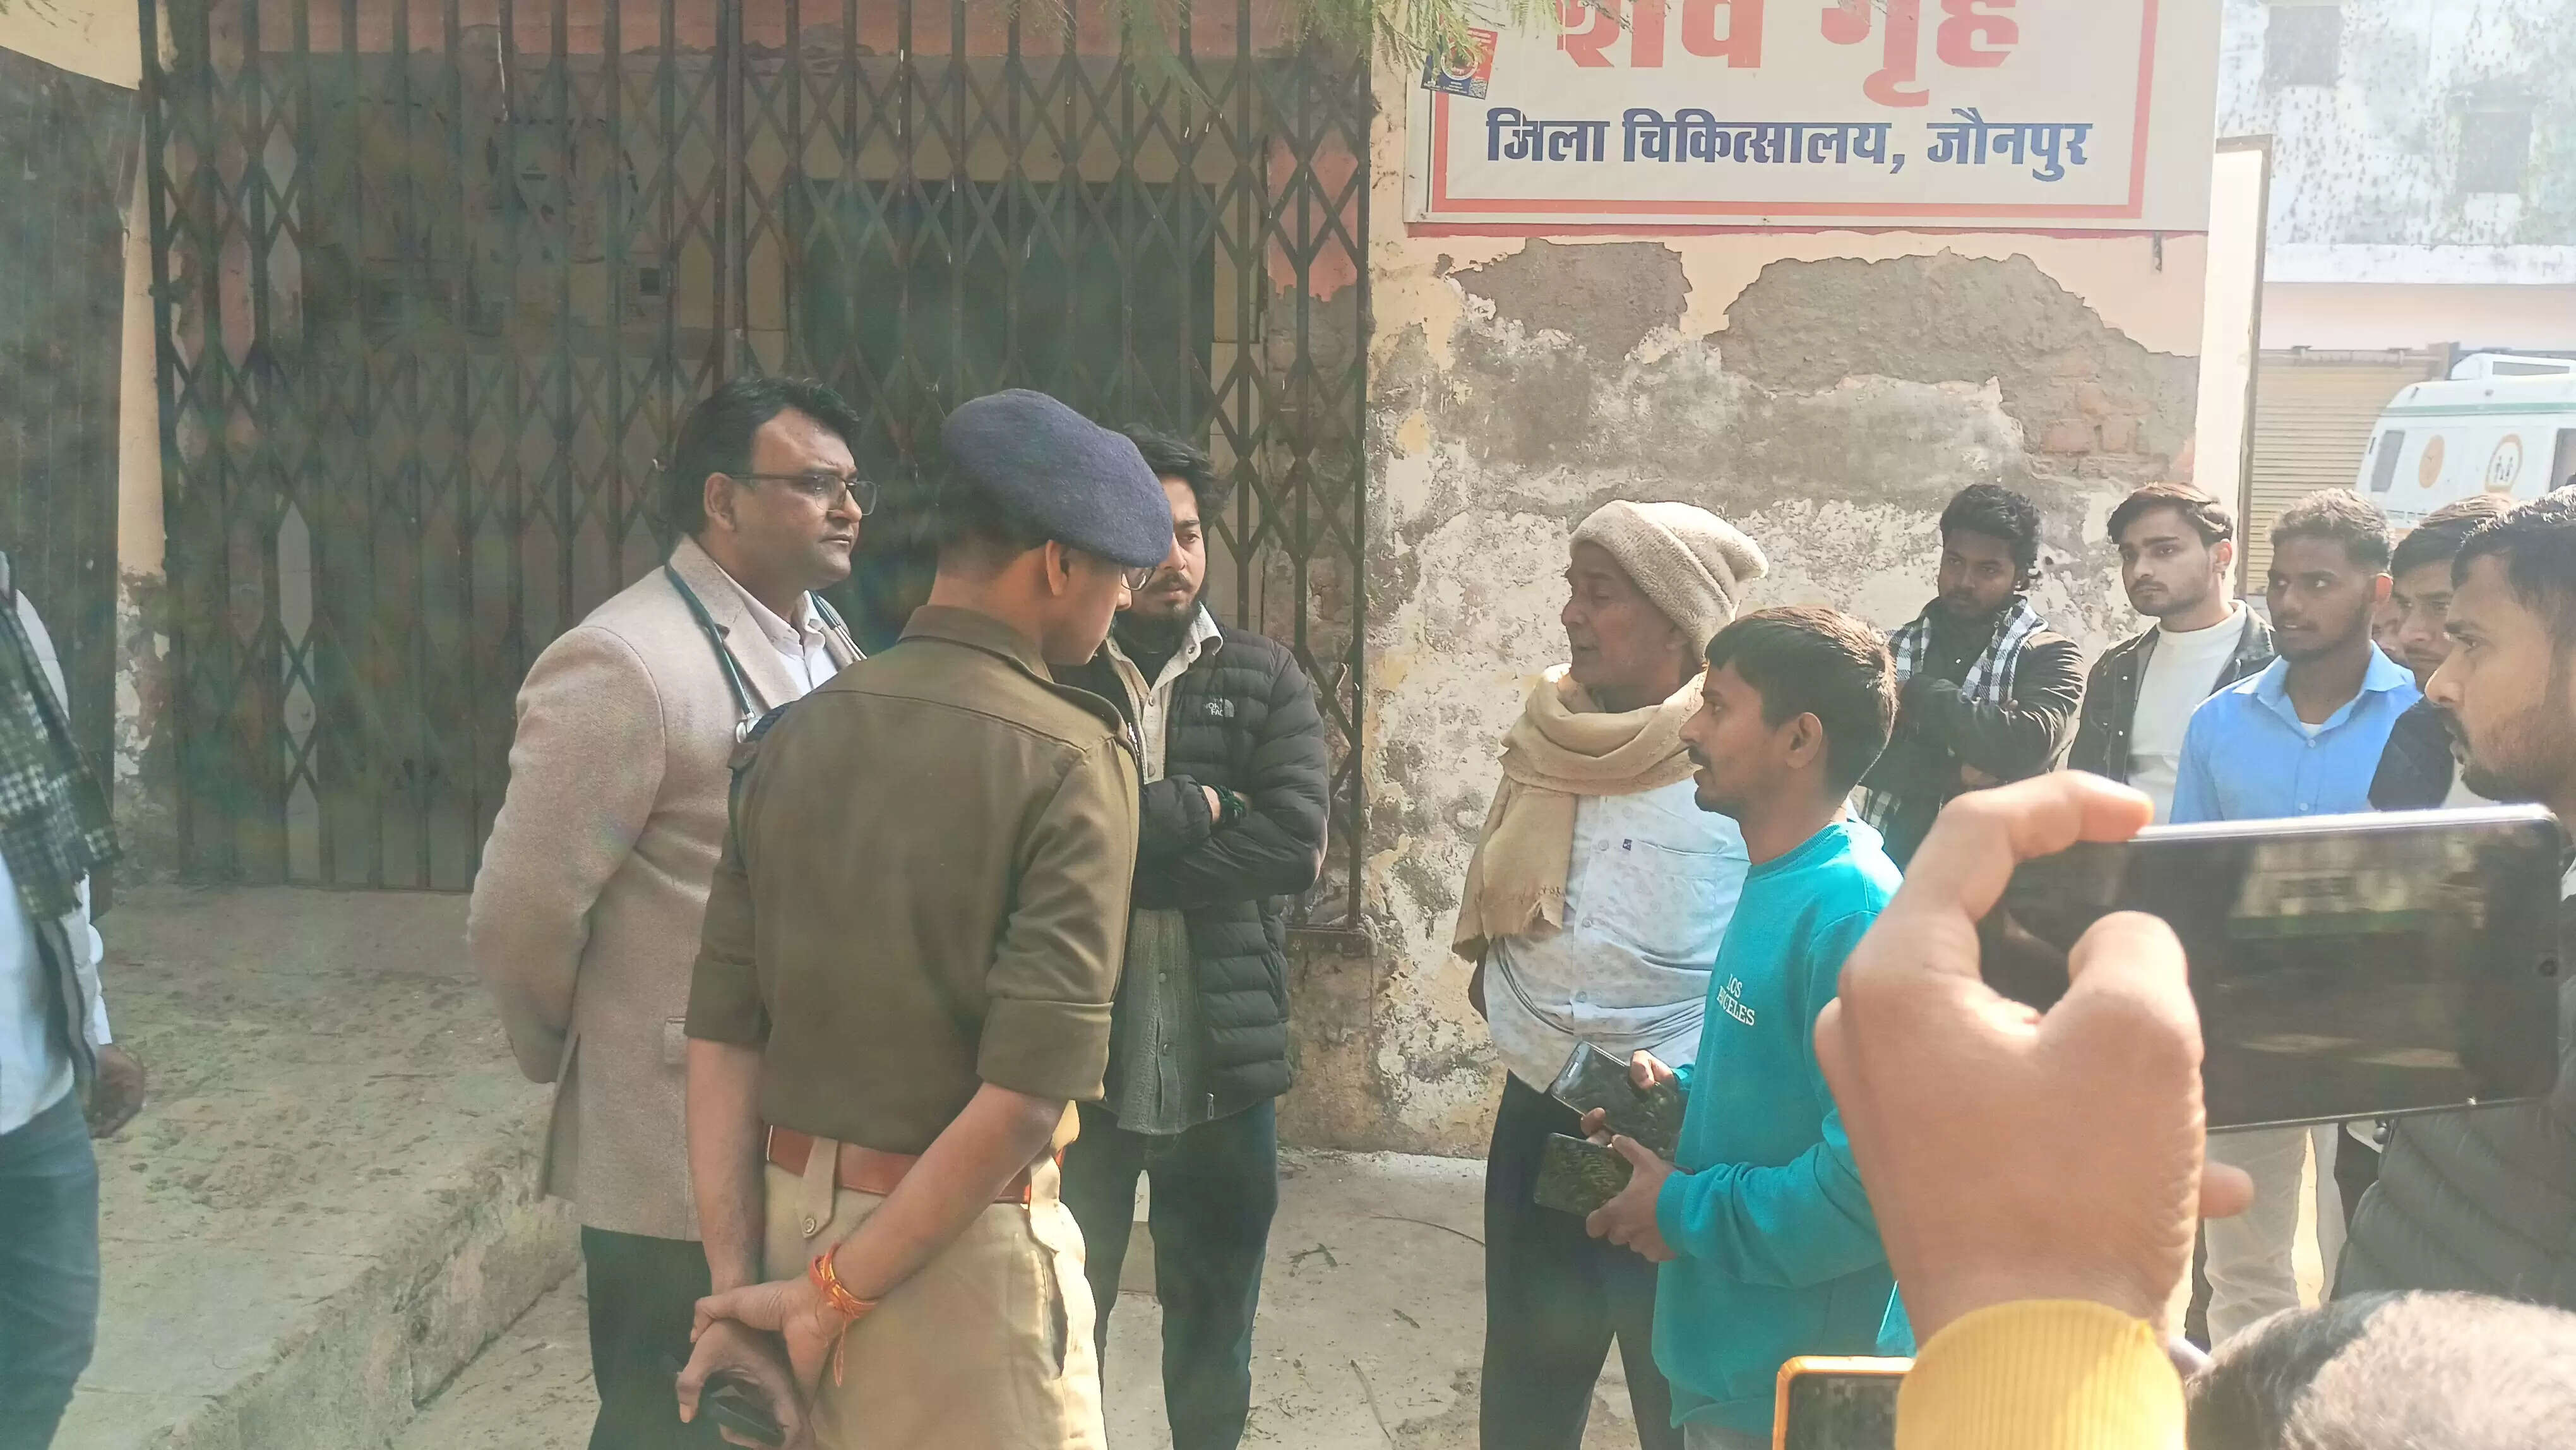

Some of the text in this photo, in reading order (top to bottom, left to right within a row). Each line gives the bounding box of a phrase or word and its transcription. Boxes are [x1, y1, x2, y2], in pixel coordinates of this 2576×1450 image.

[1486, 107, 2093, 182] जिला चिकित्सालय, जौनपुर
[1726, 973, 1743, 998] LOS
